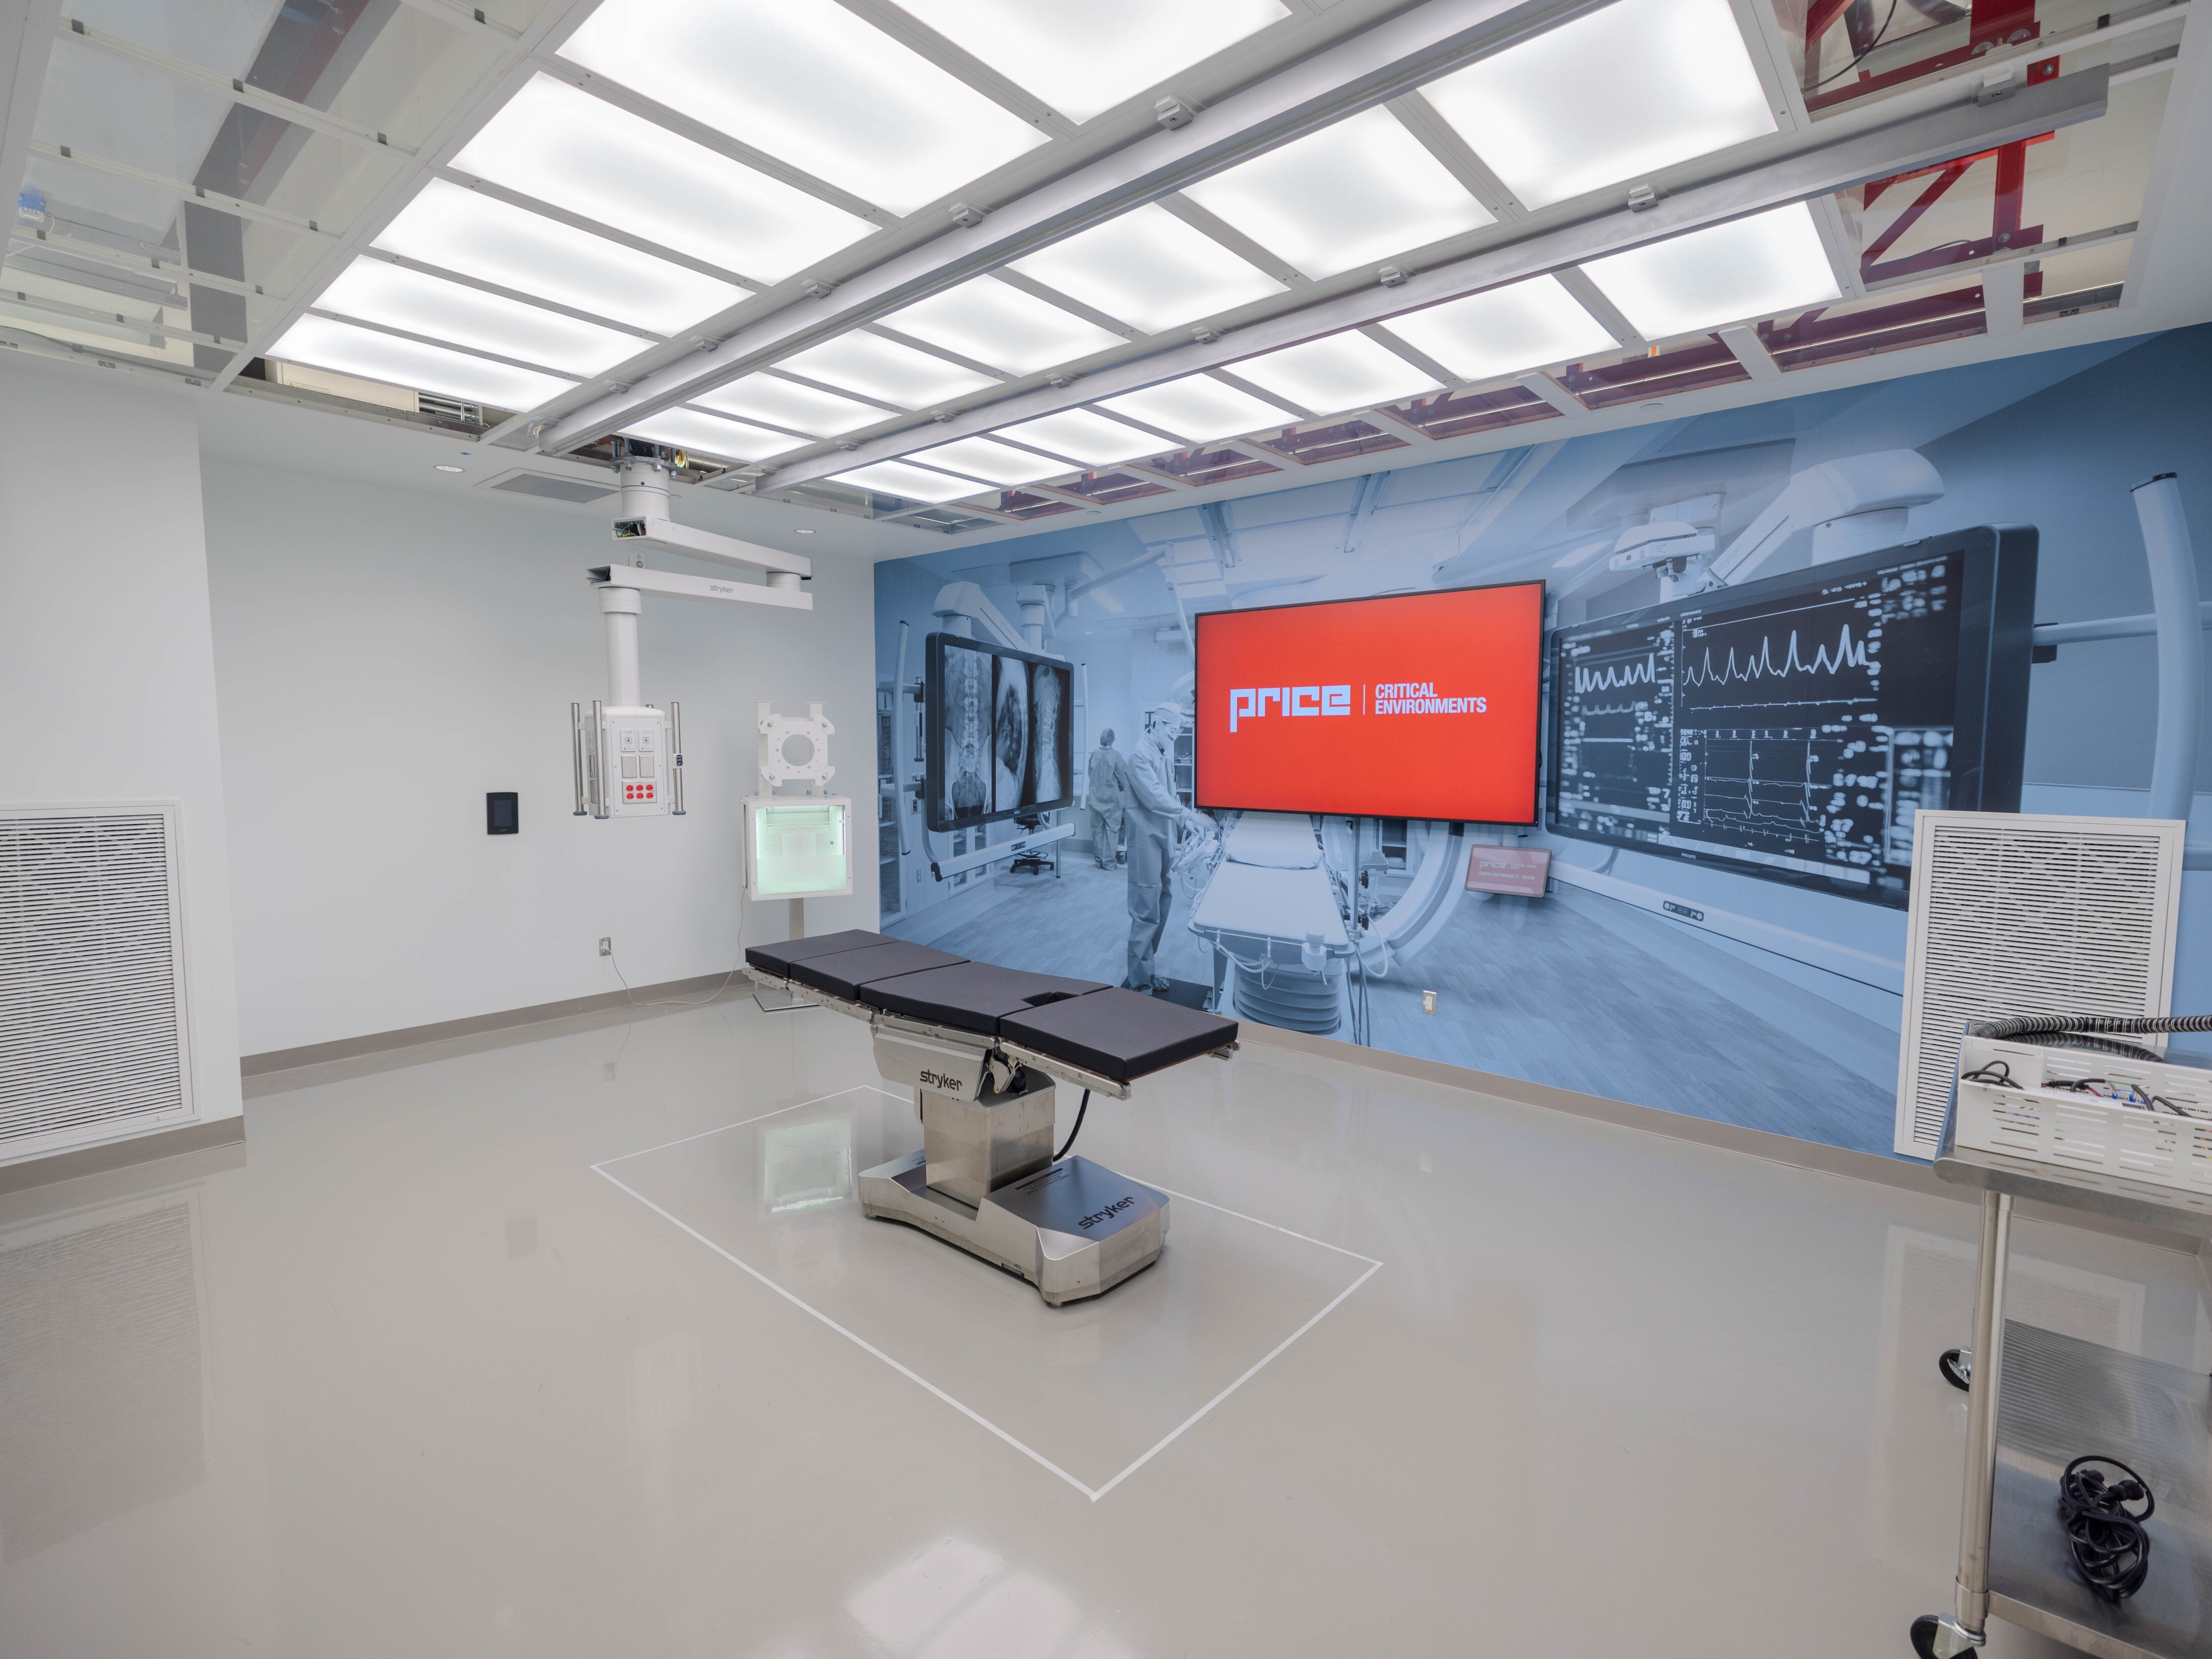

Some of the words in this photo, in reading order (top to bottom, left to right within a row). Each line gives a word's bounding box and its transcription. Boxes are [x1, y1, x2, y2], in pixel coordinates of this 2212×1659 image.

[709, 585, 734, 593] stryker
[1375, 682, 1438, 698] CRITICAL
[1230, 685, 1351, 732] price
[1375, 697, 1487, 714] ENVIRONMENTS
[920, 1069, 963, 1091] stryker
[1078, 1196, 1135, 1230] stryker
